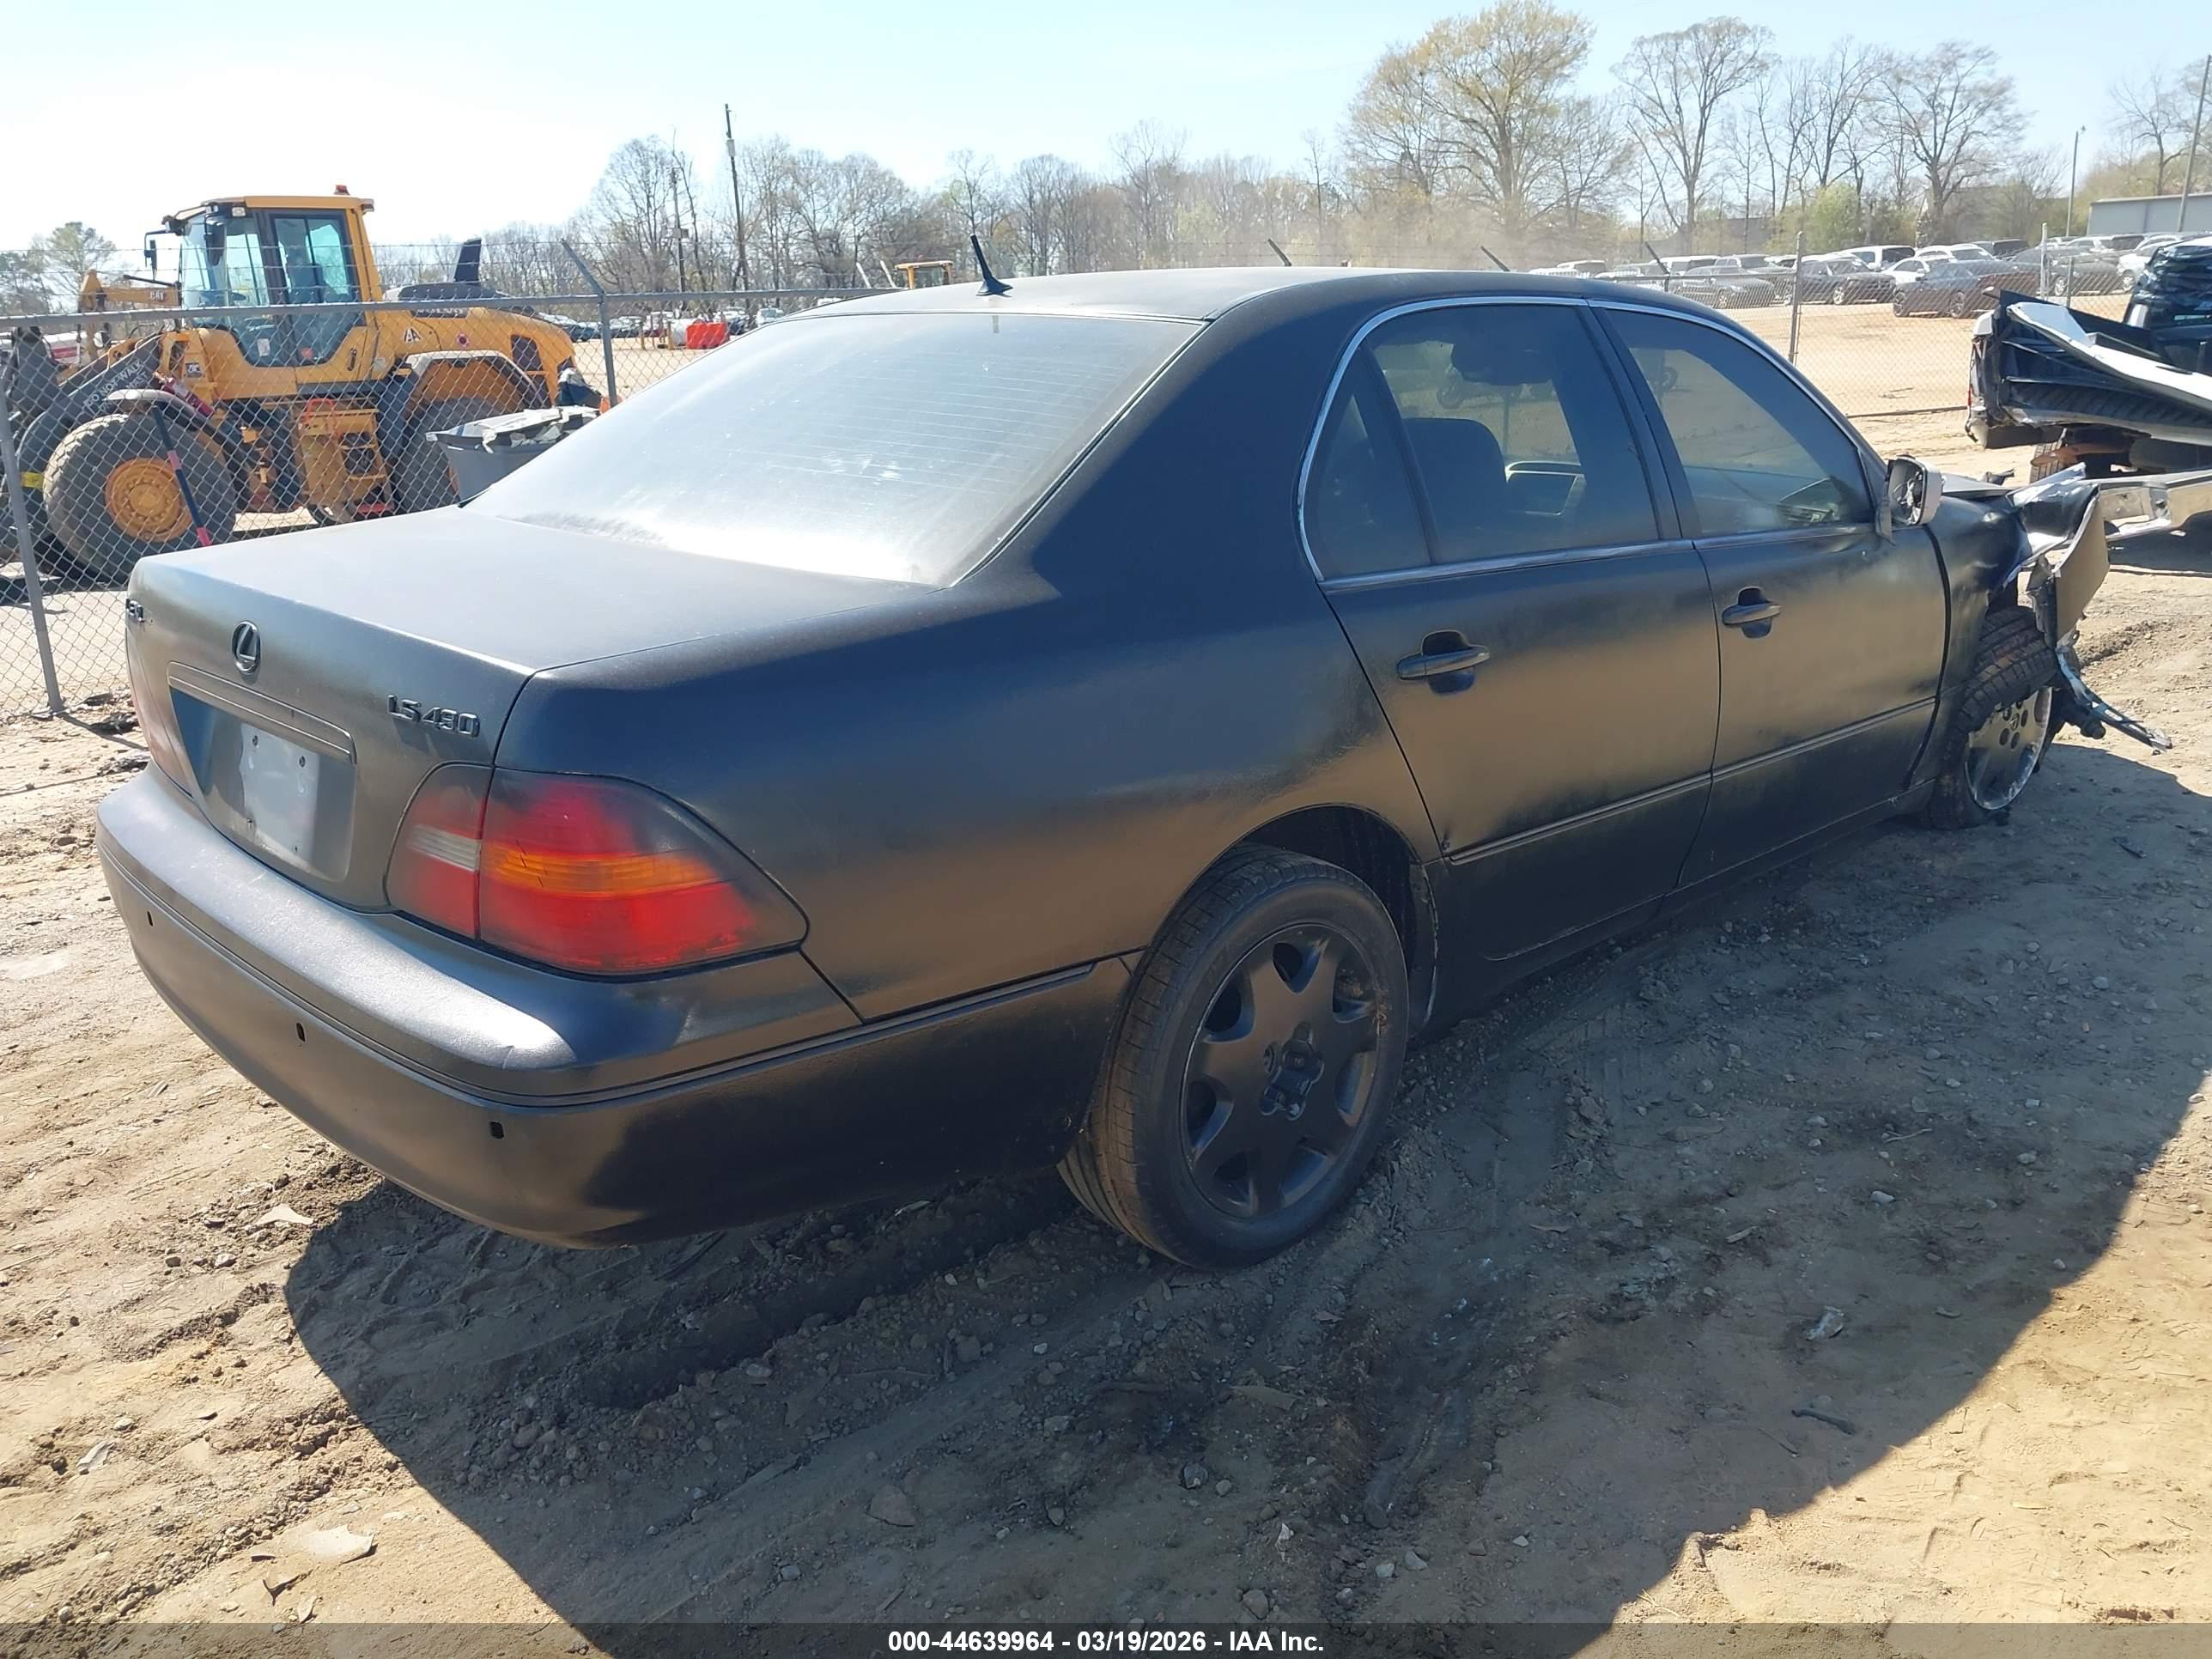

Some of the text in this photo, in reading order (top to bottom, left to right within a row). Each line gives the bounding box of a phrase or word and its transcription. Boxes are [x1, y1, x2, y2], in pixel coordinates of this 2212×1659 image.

[83, 393, 100, 408] DO
[100, 377, 118, 396] NOT
[118, 359, 143, 381] WALK
